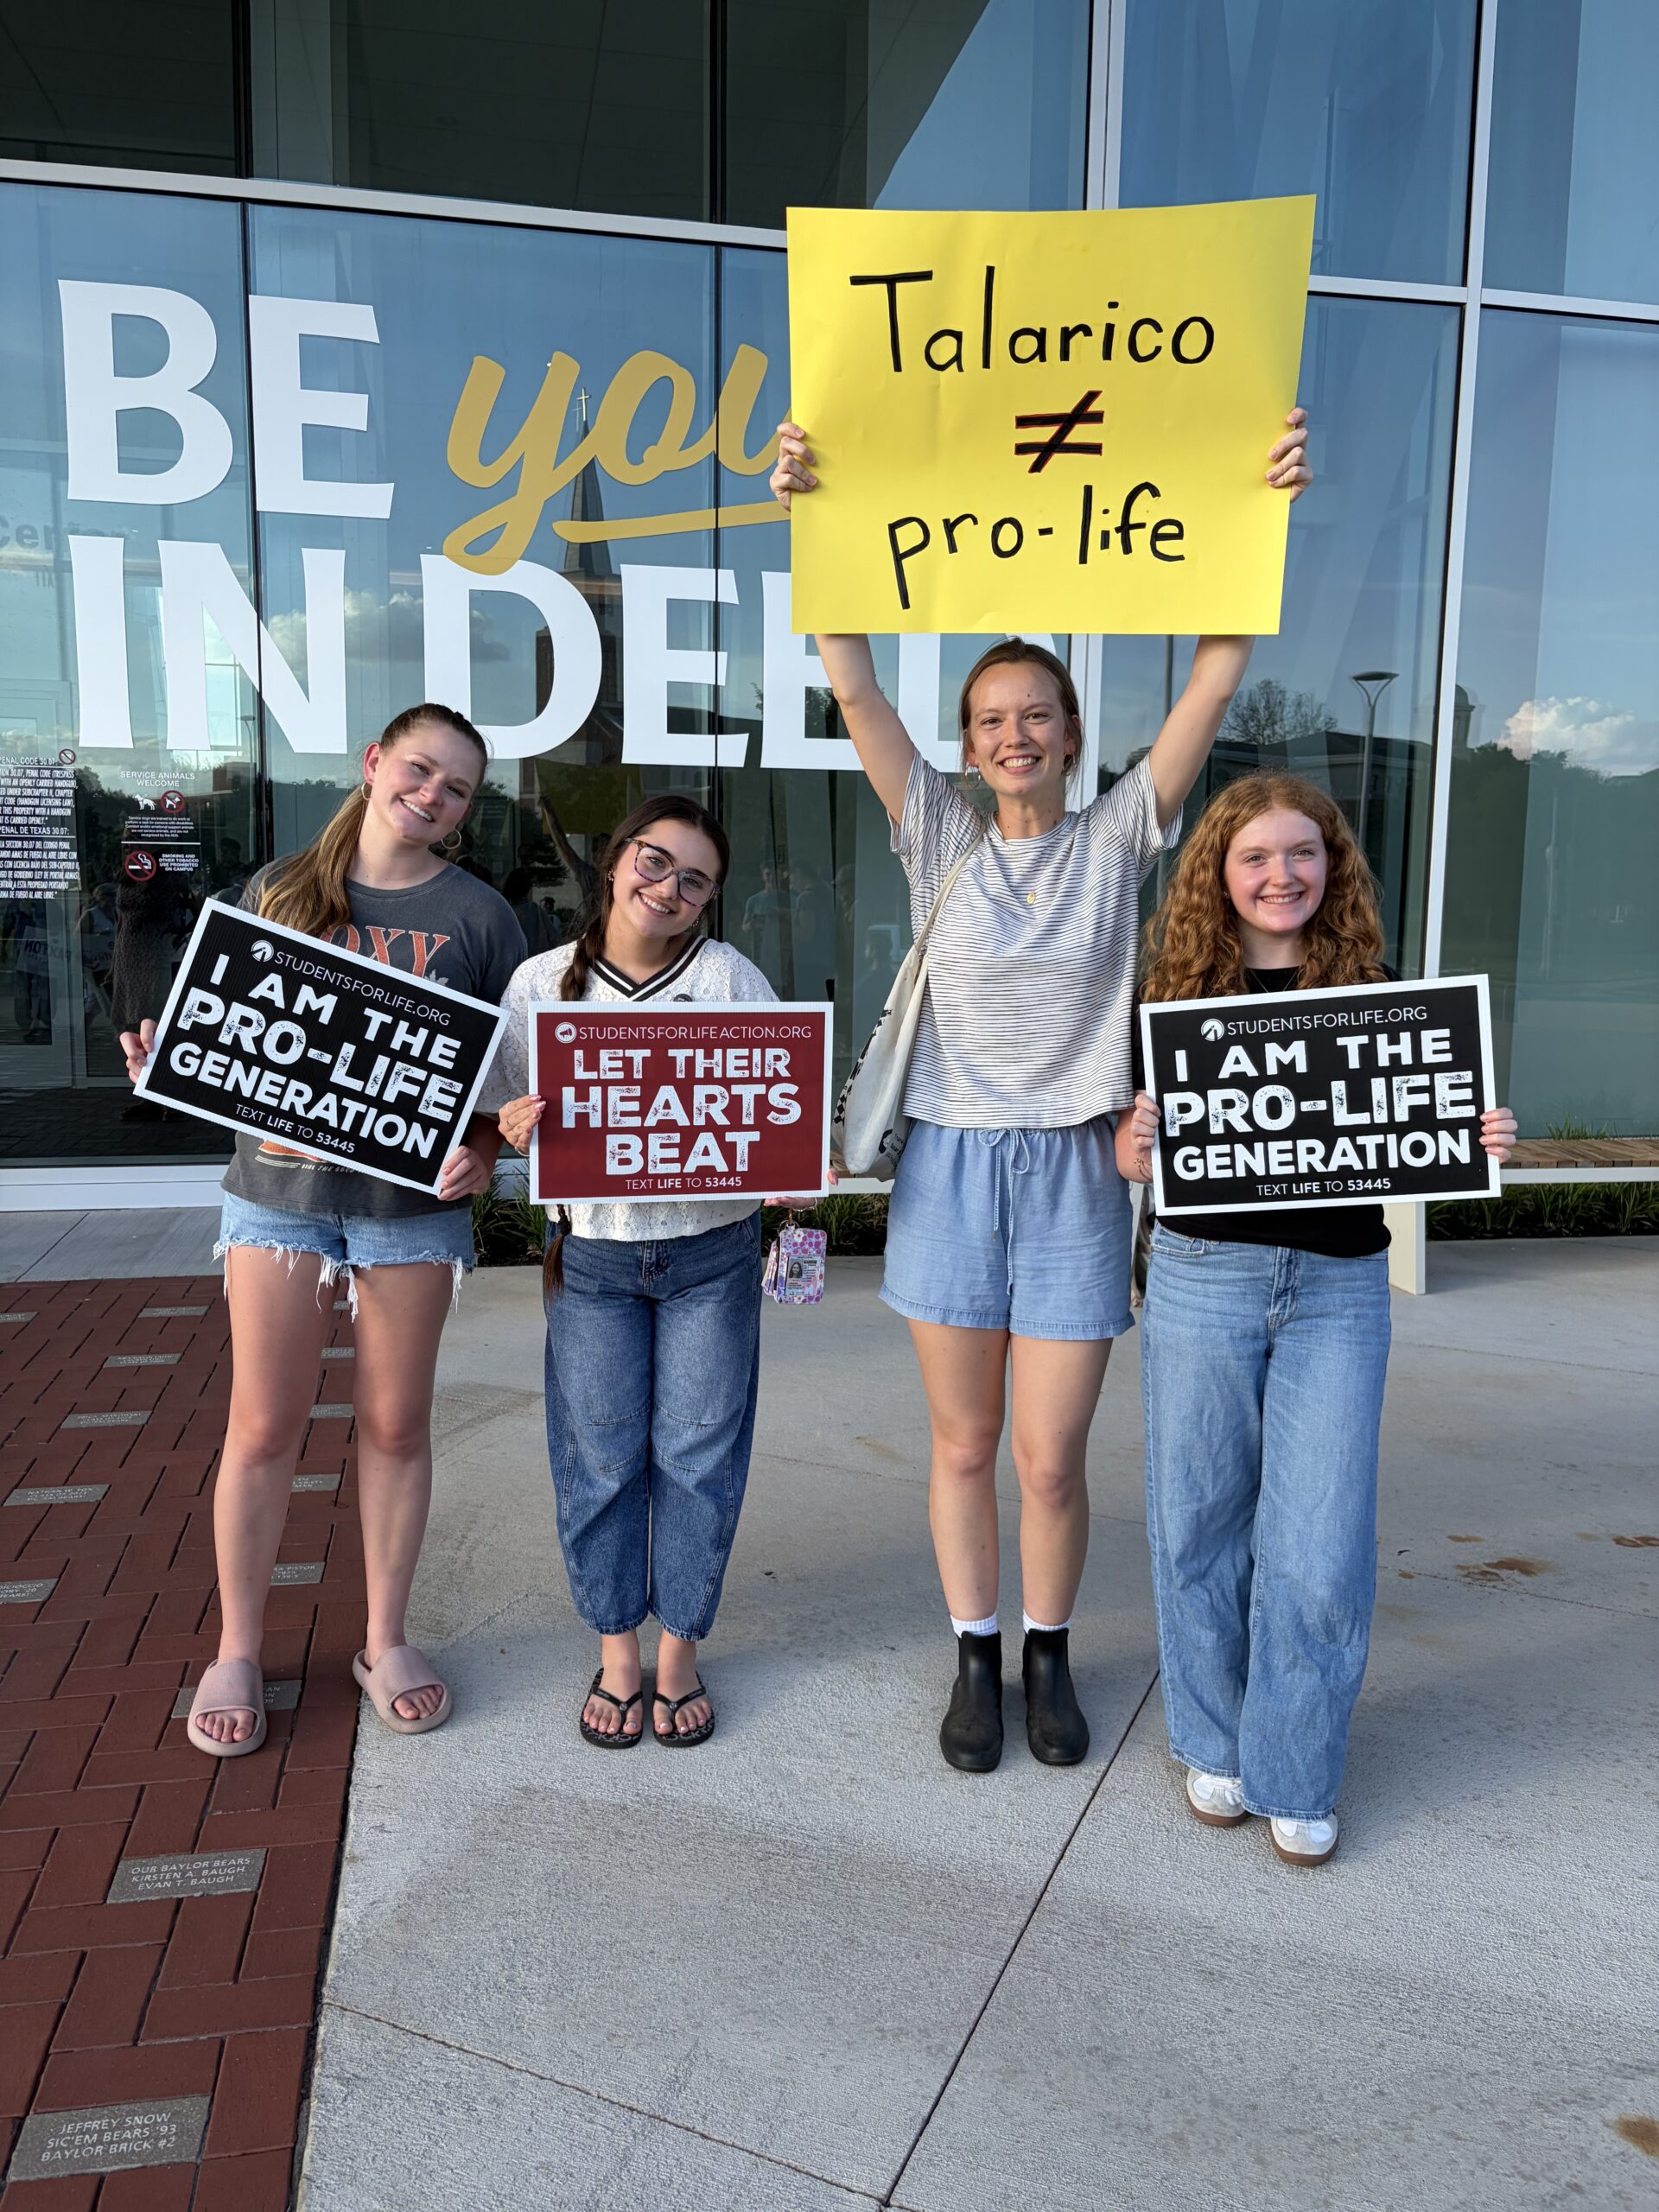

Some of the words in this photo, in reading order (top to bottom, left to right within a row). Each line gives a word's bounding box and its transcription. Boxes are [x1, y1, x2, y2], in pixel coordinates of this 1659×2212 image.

[849, 265, 1214, 372] Talarico
[58, 279, 394, 519] BE
[887, 481, 1185, 609] pro-life
[22, 788, 48, 797] SUBCHAPTER
[5, 816, 9, 824] IS
[35, 807, 47, 816] WITH
[275, 951, 451, 1026] STUDENTSFORLIFE.ORG
[209, 953, 231, 986] I
[248, 972, 339, 1025] AM
[363, 1007, 461, 1070] THE
[1227, 1007, 1427, 1036] STUDENTSFORLIFE.ORG
[579, 1026, 812, 1040] STUDENTSFORLIFEACTION.ORG
[176, 987, 463, 1122] PRO-LIFE
[574, 1049, 652, 1080] LET
[668, 1048, 791, 1079] THEIR
[1175, 1049, 1188, 1082] I
[1218, 1040, 1308, 1079] AM
[1336, 1028, 1452, 1070] THE
[168, 1042, 439, 1159] GENERATION
[562, 1083, 802, 1128] HEARTS
[1163, 1071, 1477, 1137] PRO-LIFE
[235, 1103, 264, 1122] TEXT
[267, 1113, 292, 1134] LIFE
[296, 1123, 313, 1139] TO
[315, 1132, 356, 1154] 53445
[605, 1130, 760, 1175] BEAT
[1173, 1128, 1471, 1181] GENERATION
[626, 1179, 654, 1190] TEXT
[658, 1178, 682, 1189] LIFE
[686, 1177, 702, 1189] TO
[705, 1176, 742, 1187] 53445
[1256, 1183, 1288, 1197] TEXT
[1293, 1181, 1320, 1194] LIFE
[1324, 1179, 1343, 1192] TO
[1348, 1177, 1391, 1191] 53445
[131, 1866, 157, 1875] OUR
[161, 1861, 209, 1872] BAYLOR
[213, 1858, 251, 1867] BEARS
[131, 1872, 181, 1882] KIRSTEN
[202, 1866, 245, 1877] BAUGH
[138, 1881, 172, 1891] EVAN
[190, 1875, 234, 1885] BAUGH
[47, 2134, 97, 2148] SIC'EM
[103, 2127, 150, 2143] BEARS
[156, 2124, 176, 2136] '93
[60, 2119, 123, 2134] JEFFREY
[124, 2112, 171, 2127] SNOW
[41, 2145, 104, 2162] BAYLOR
[109, 2139, 152, 2153] BRICK
[157, 2138, 175, 2150] #2
